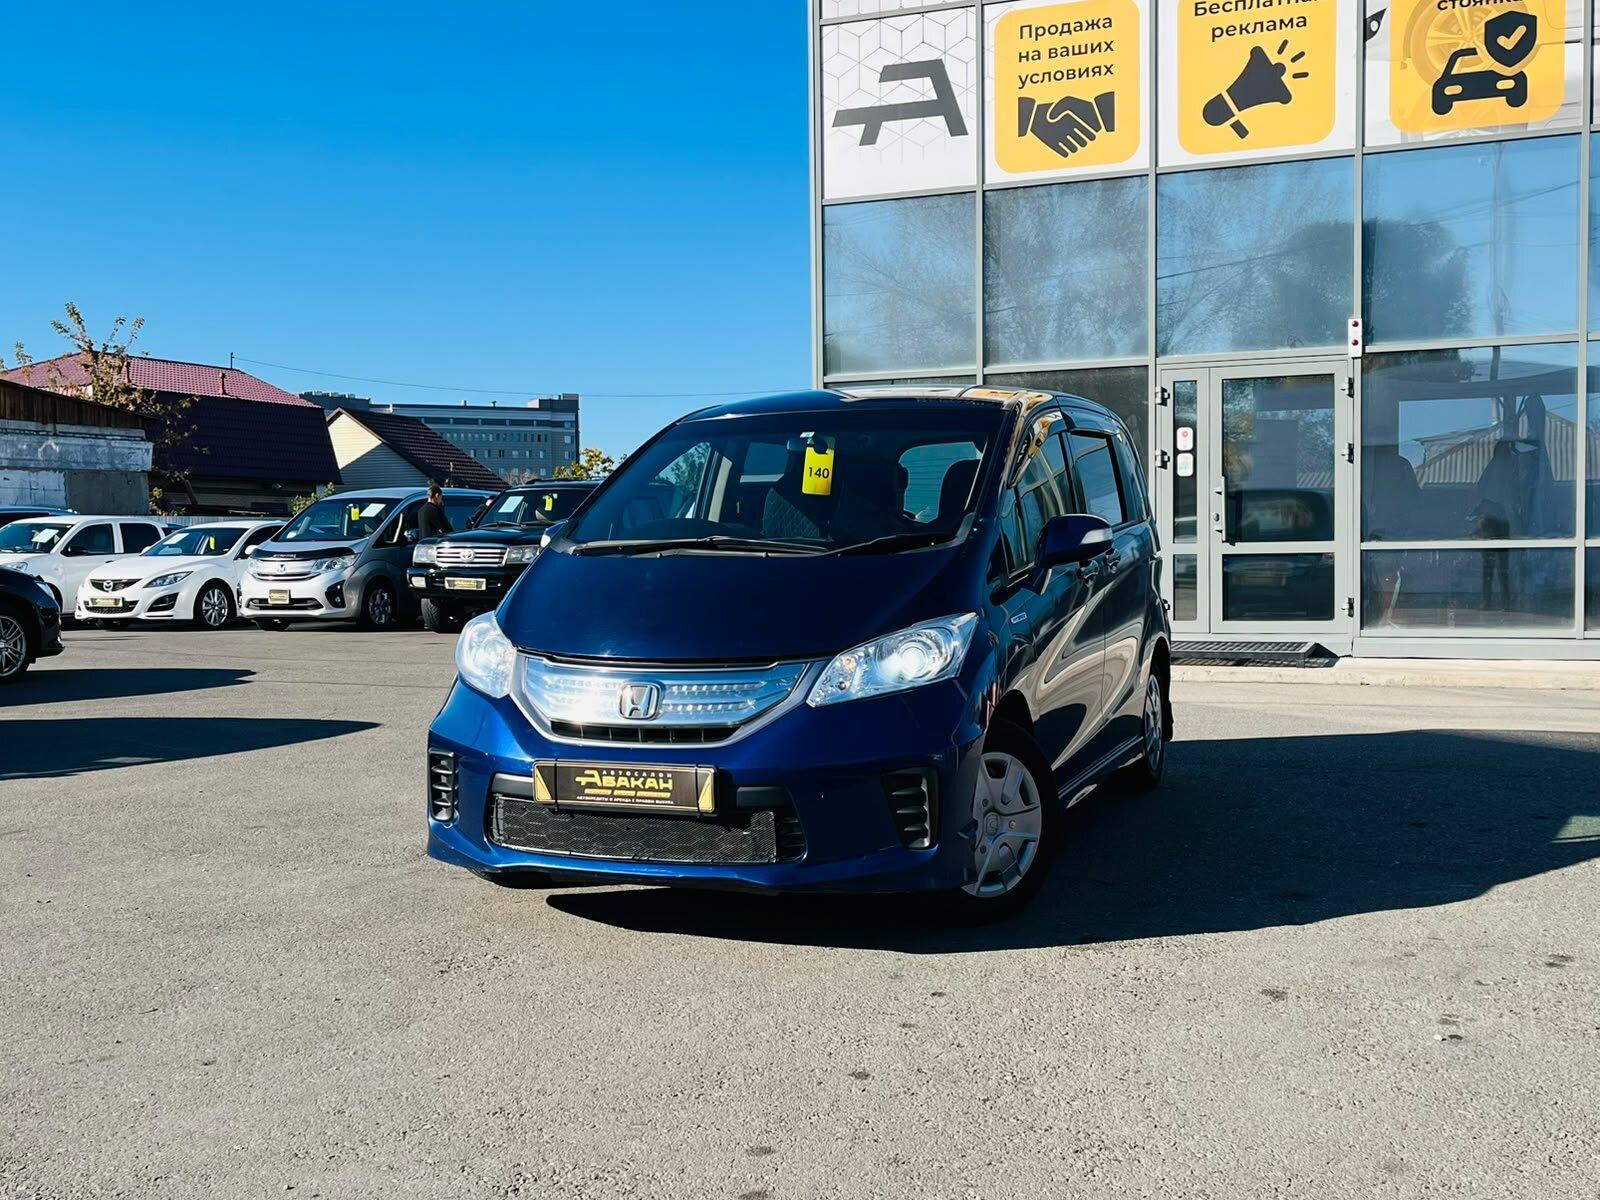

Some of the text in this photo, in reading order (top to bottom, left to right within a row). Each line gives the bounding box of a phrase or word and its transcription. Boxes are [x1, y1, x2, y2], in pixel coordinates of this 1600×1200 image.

[1194, 0, 1317, 16] Беспла
[1437, 0, 1520, 10] стоя
[1019, 17, 1113, 41] Продажа
[1211, 15, 1308, 42] реклама
[1018, 40, 1114, 63] на ваших
[1018, 64, 1114, 89] условиях
[808, 466, 830, 479] 140
[575, 769, 673, 790] АБАКАН
[602, 769, 673, 779] АВТОСАЛОН
